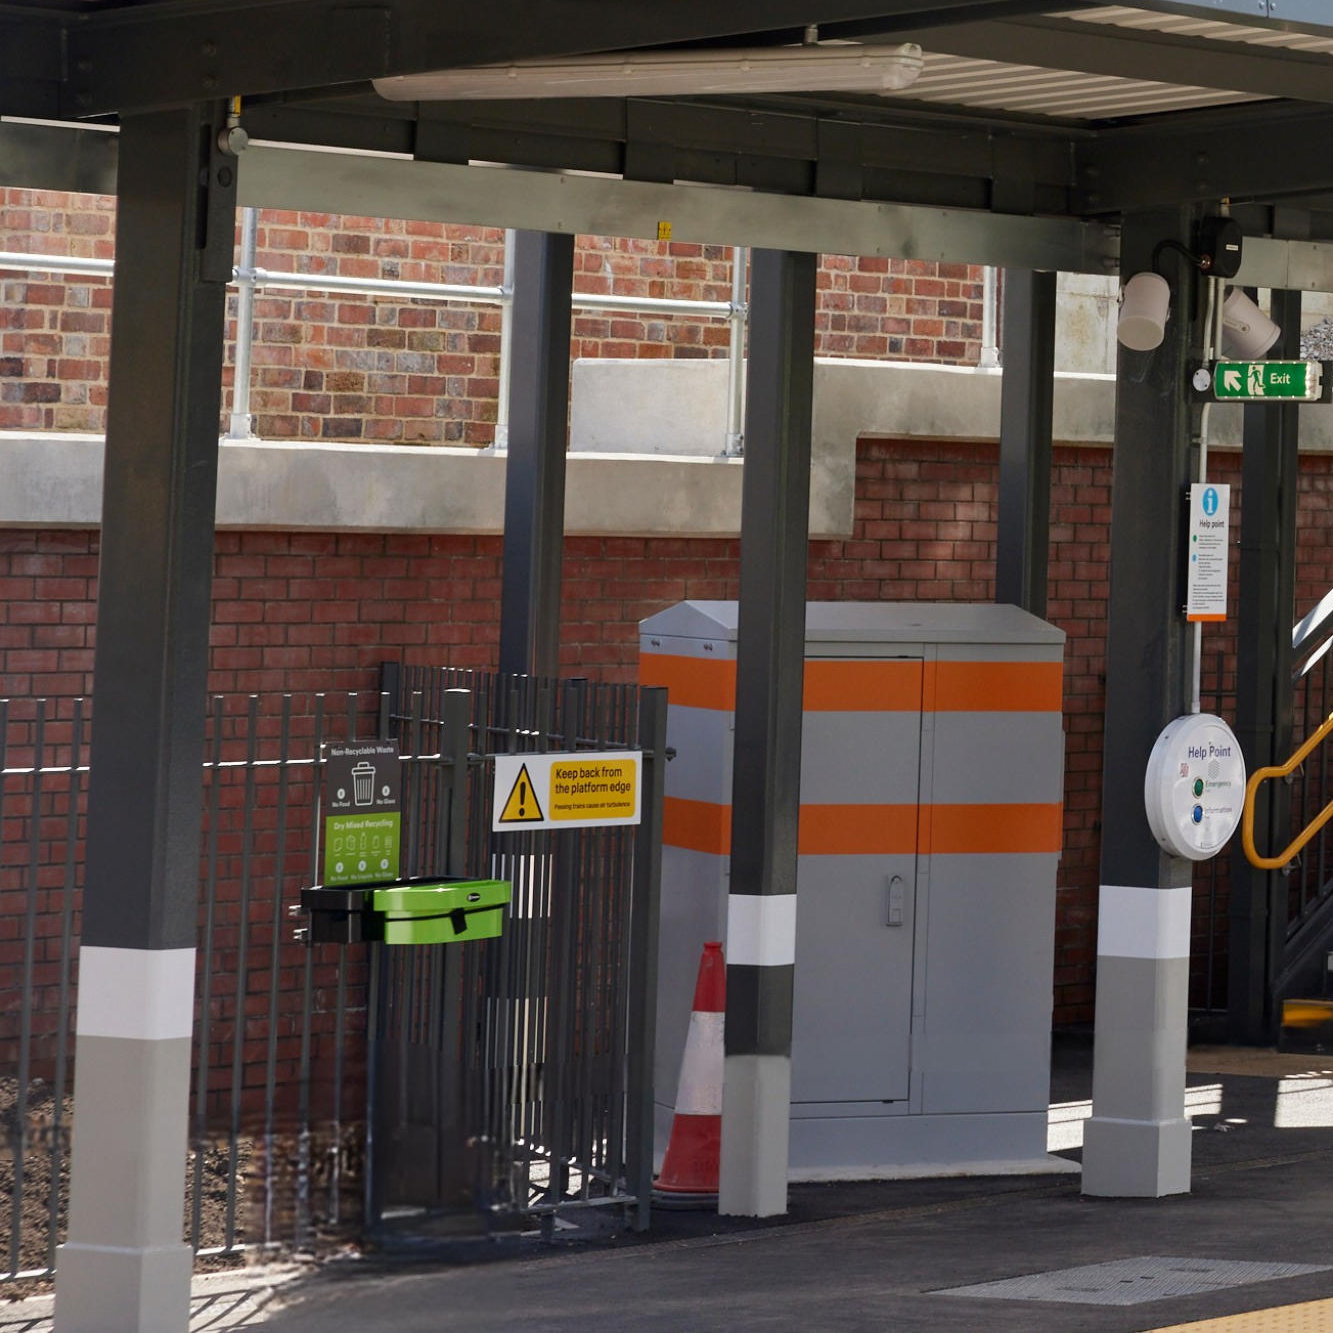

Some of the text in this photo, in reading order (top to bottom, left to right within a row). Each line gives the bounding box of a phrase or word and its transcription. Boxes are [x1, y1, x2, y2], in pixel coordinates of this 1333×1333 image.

[1270, 372, 1291, 385] Exit
[1199, 519, 1225, 529] Help point
[331, 746, 394, 756] Non-Recyclable Waste
[1188, 745, 1231, 760] Help Point
[556, 766, 622, 781] Keep back from
[555, 781, 631, 796] the platform edge
[1205, 780, 1231, 788] Emergency
[333, 818, 393, 831] Dry Mixed Recycling
